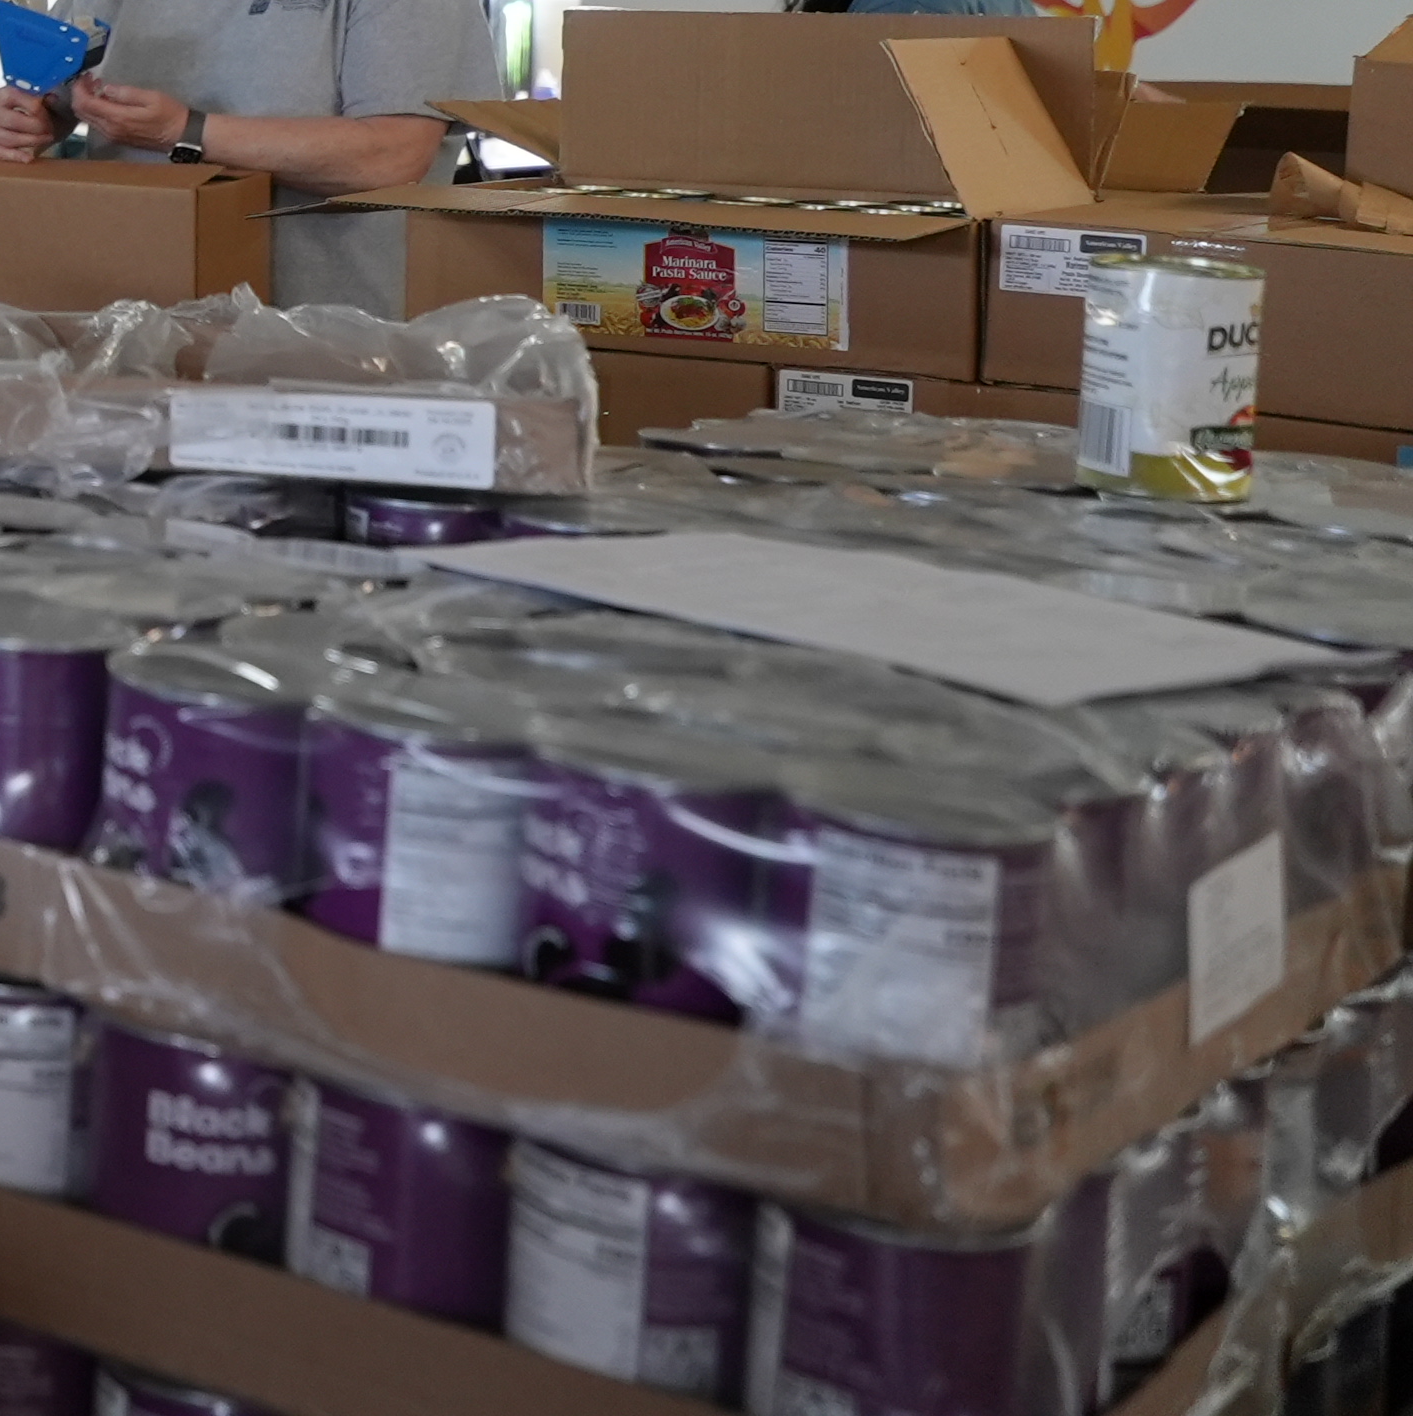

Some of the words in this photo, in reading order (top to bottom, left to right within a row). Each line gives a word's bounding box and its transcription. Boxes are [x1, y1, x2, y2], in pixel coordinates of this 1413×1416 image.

[651, 265, 686, 279] Pasta
[689, 268, 727, 281] Sauce
[662, 255, 717, 269] Marinara
[1207, 323, 1259, 353] DUC
[147, 1088, 270, 1138] Black
[144, 1126, 276, 1174] Beans
